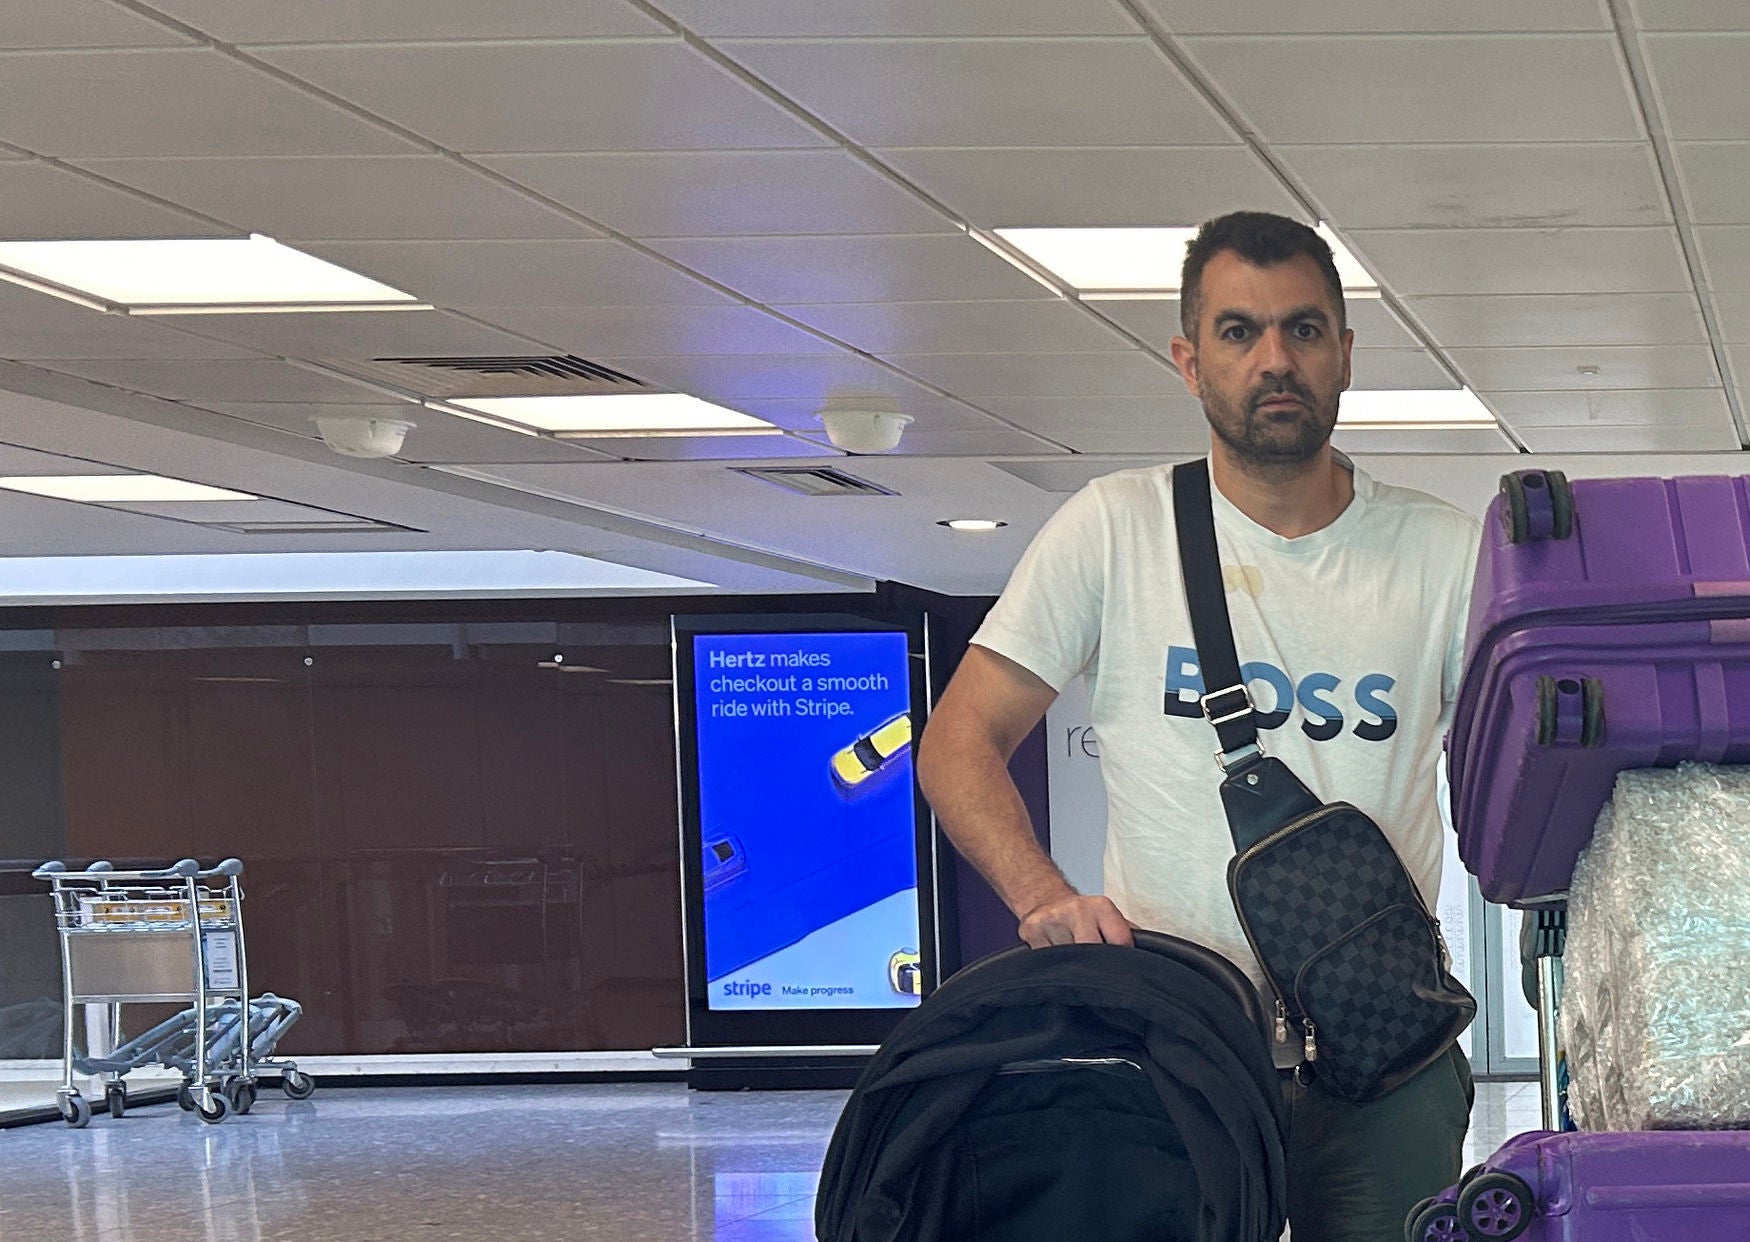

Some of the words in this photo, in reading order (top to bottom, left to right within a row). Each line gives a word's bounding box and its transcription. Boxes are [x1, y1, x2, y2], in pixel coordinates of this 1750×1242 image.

[709, 650, 766, 668] Hertz
[770, 649, 831, 667] makes
[710, 674, 797, 693] checkout
[801, 678, 813, 692] a
[816, 673, 889, 692] smooth
[1164, 645, 1398, 742] BOSS
[711, 699, 748, 717] ride
[750, 699, 791, 717] with
[795, 698, 855, 720] Stripe.
[723, 979, 772, 999] stripe
[781, 986, 808, 995] Make
[810, 986, 854, 997] progress
